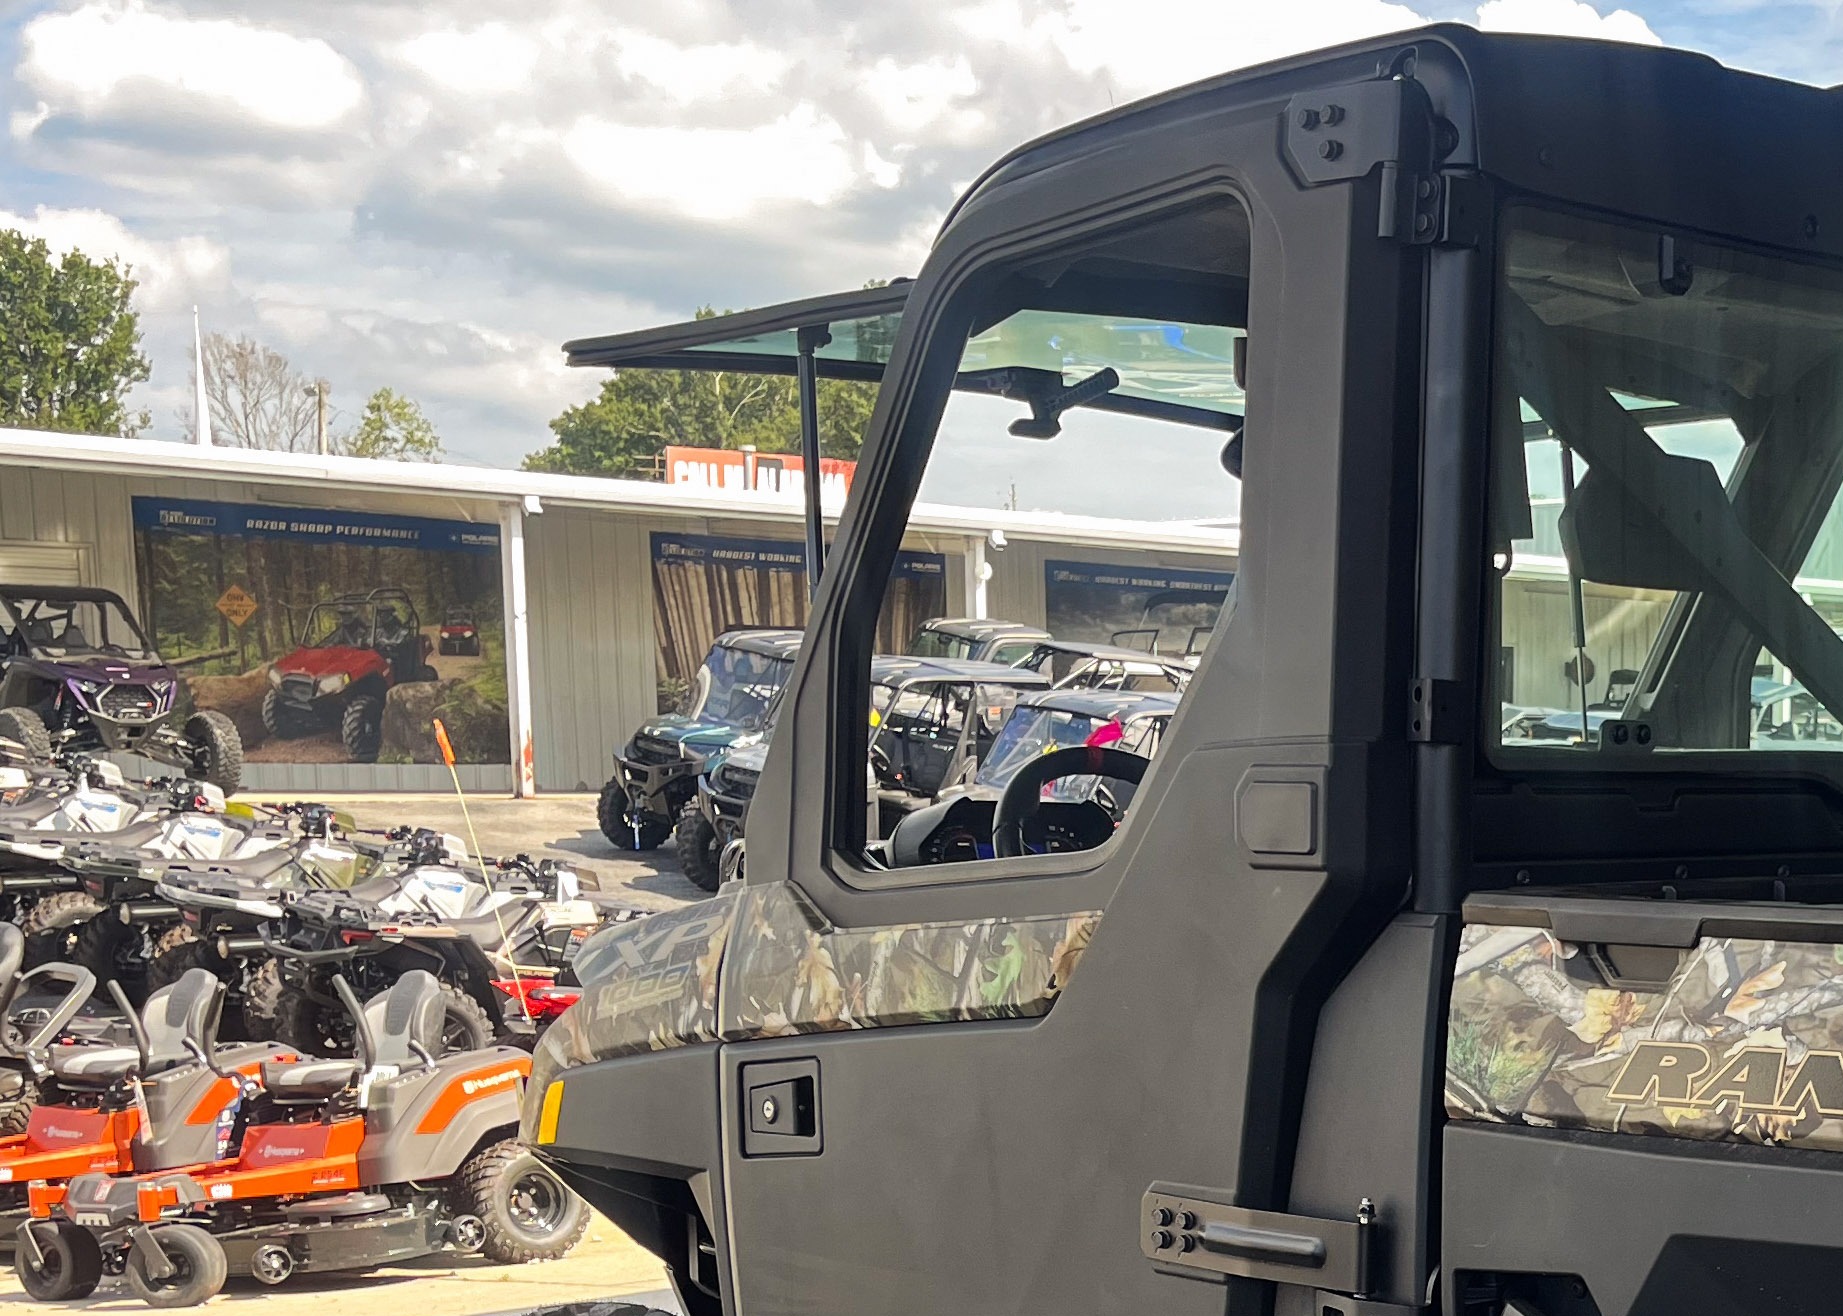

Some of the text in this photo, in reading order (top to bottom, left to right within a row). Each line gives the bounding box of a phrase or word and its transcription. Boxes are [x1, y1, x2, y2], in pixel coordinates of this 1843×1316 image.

[246, 519, 421, 540] RAZOR SHARP PERFORMANCE
[758, 552, 803, 564] WORKING
[600, 912, 726, 982] XP
[597, 958, 692, 1020] 1000
